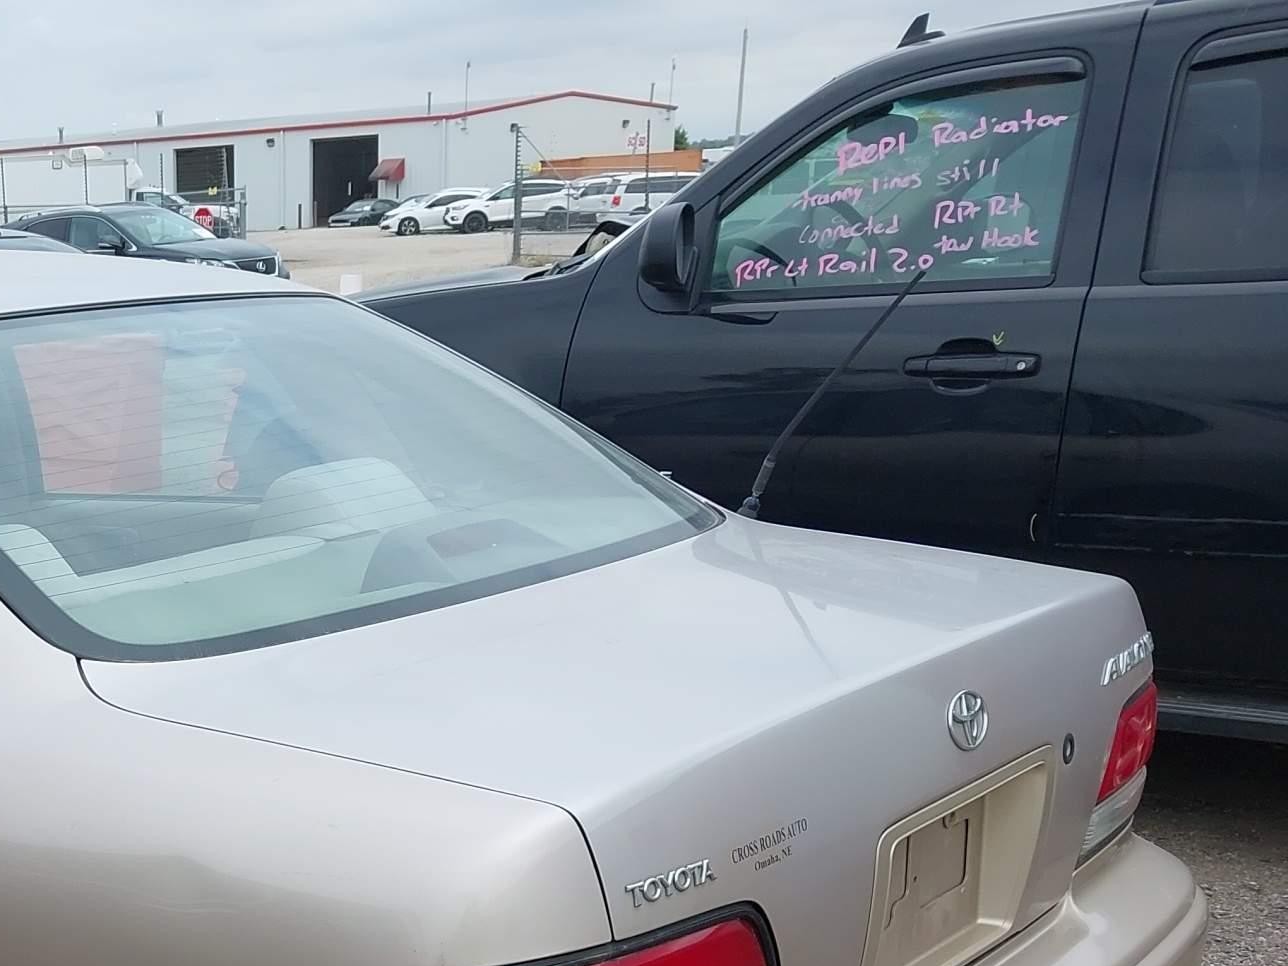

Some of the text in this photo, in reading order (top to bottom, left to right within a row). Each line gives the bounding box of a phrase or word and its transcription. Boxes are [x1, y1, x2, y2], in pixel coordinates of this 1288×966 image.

[931, 108, 1069, 147] Radiator
[935, 158, 1000, 186] still
[195, 215, 212, 226] STOP
[818, 247, 877, 277] Rail
[887, 247, 934, 273] 2.0
[731, 818, 808, 864] CROSS ROADS AUTO
[781, 845, 793, 859] NE
[625, 859, 717, 908] TOYOTA
